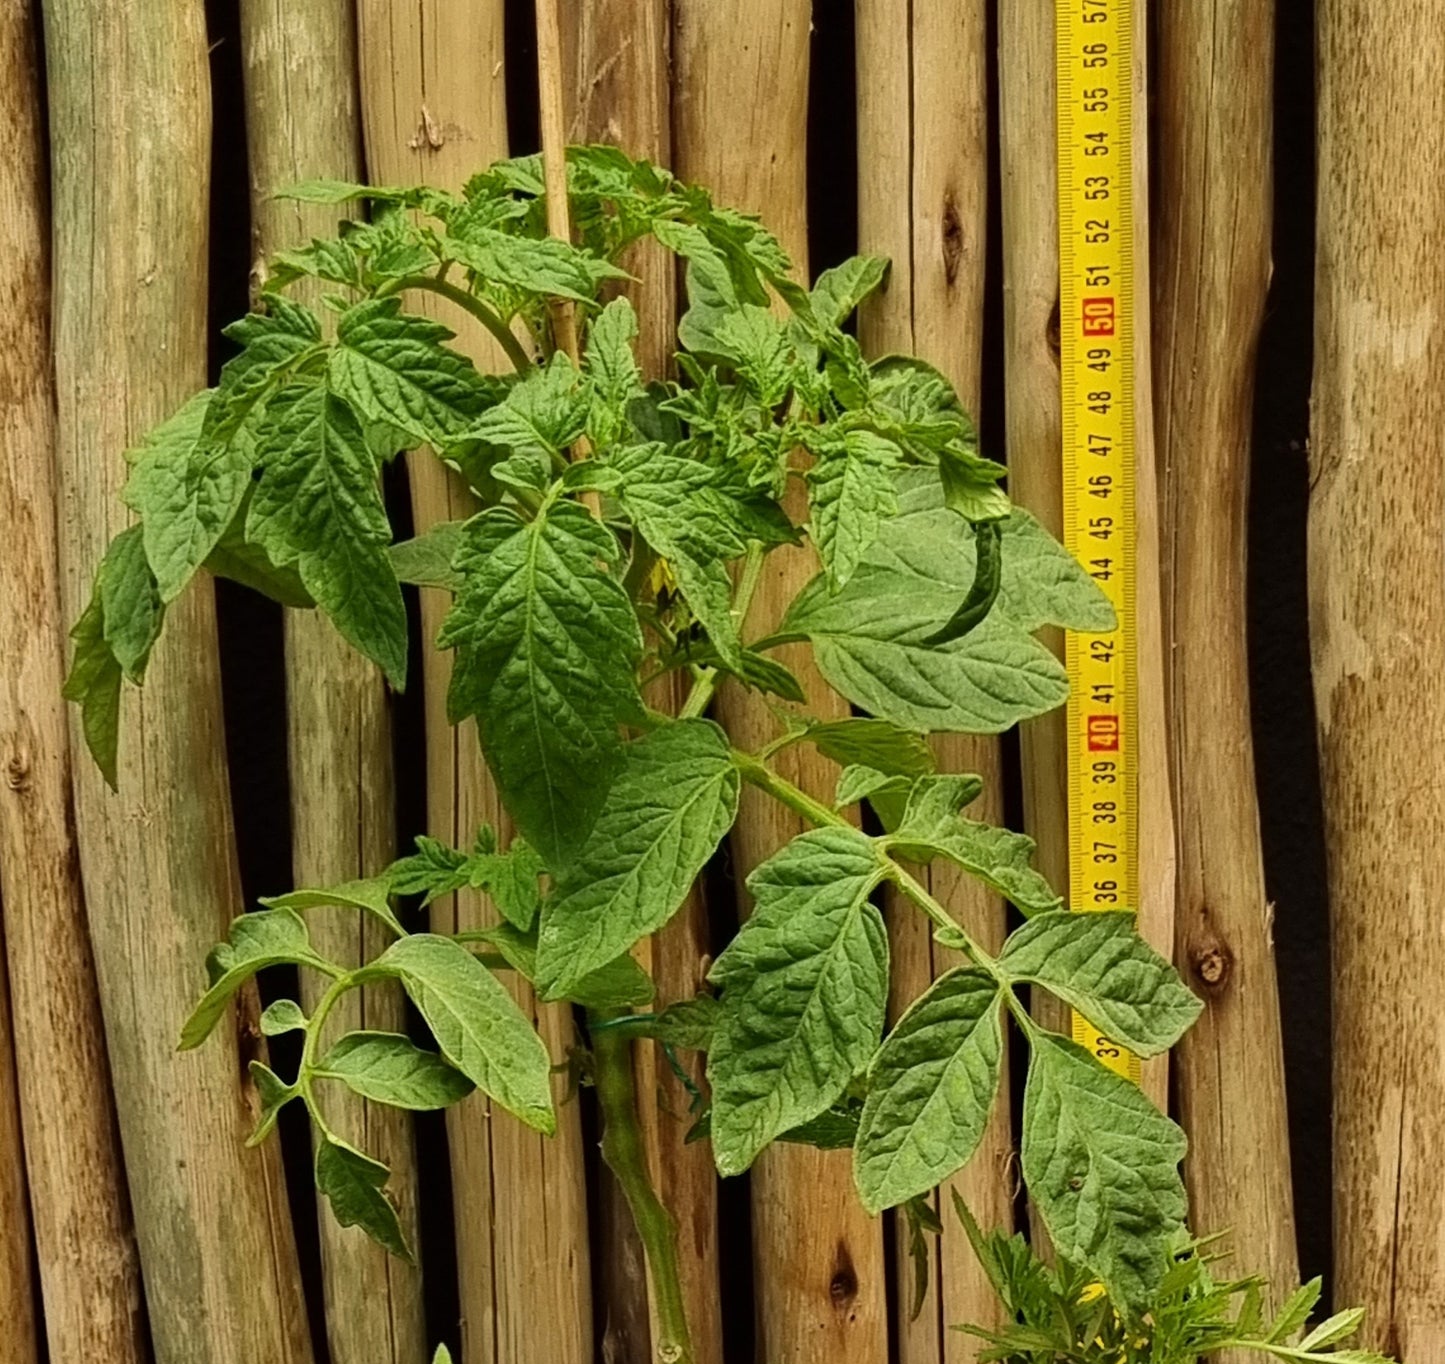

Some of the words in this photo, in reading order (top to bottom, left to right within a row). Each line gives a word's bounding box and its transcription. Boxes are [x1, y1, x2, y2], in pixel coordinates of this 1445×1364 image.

[1082, 0, 1107, 23] 57
[1083, 43, 1108, 68] 56
[1083, 87, 1108, 112] 55
[1084, 132, 1109, 156] 54
[1085, 176, 1109, 200] 53
[1085, 219, 1110, 243] 52
[1086, 265, 1110, 286] 51
[1084, 303, 1113, 331] 50
[1087, 348, 1111, 372] 49
[1087, 391, 1112, 414] 48
[1088, 434, 1112, 456] 47
[1089, 475, 1113, 498] 46
[1089, 517, 1113, 540] 45
[1090, 558, 1113, 581] 44
[1091, 640, 1114, 663] 42
[1091, 684, 1114, 704] 41
[1090, 721, 1117, 748] 40
[1092, 761, 1116, 784] 39
[1093, 801, 1117, 824] 38
[1094, 842, 1117, 864] 37
[1094, 880, 1118, 903] 36
